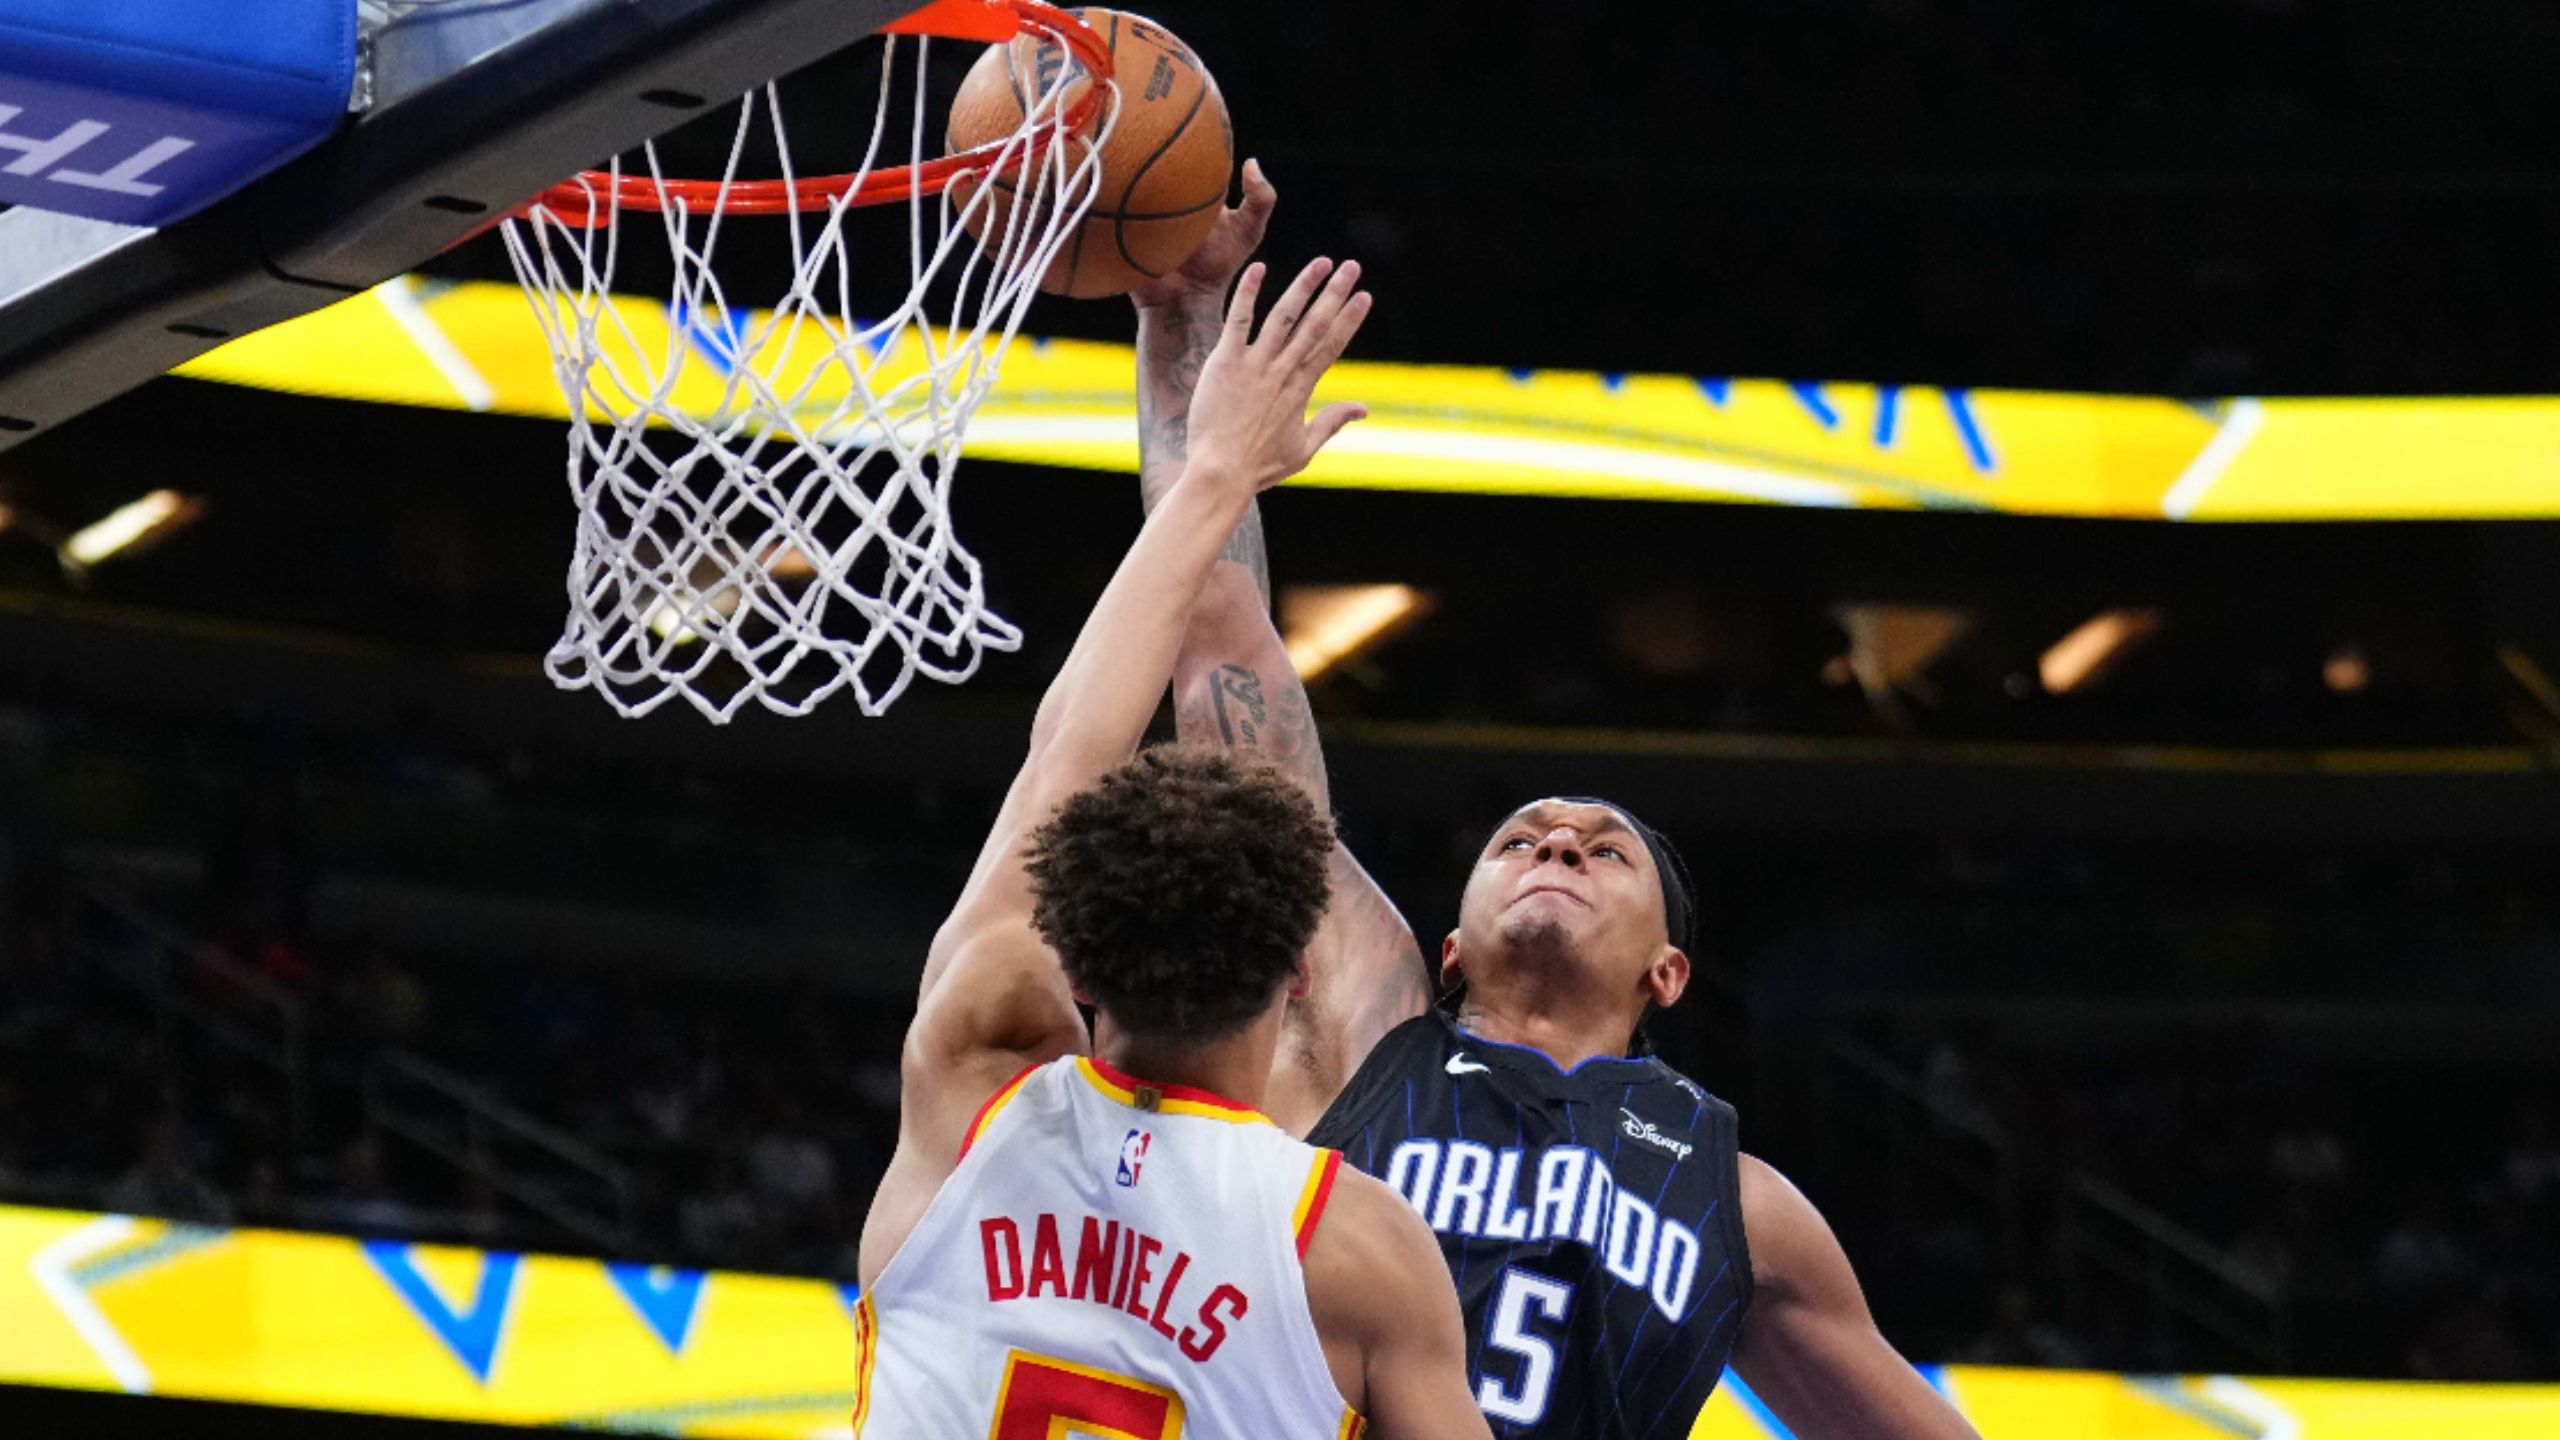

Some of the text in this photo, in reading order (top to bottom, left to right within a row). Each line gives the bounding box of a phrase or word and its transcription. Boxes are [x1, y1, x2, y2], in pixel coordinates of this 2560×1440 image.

[978, 1213, 1248, 1363] DANIELS
[1386, 1137, 1700, 1325] ORLANDO
[1478, 1265, 1575, 1425] 5
